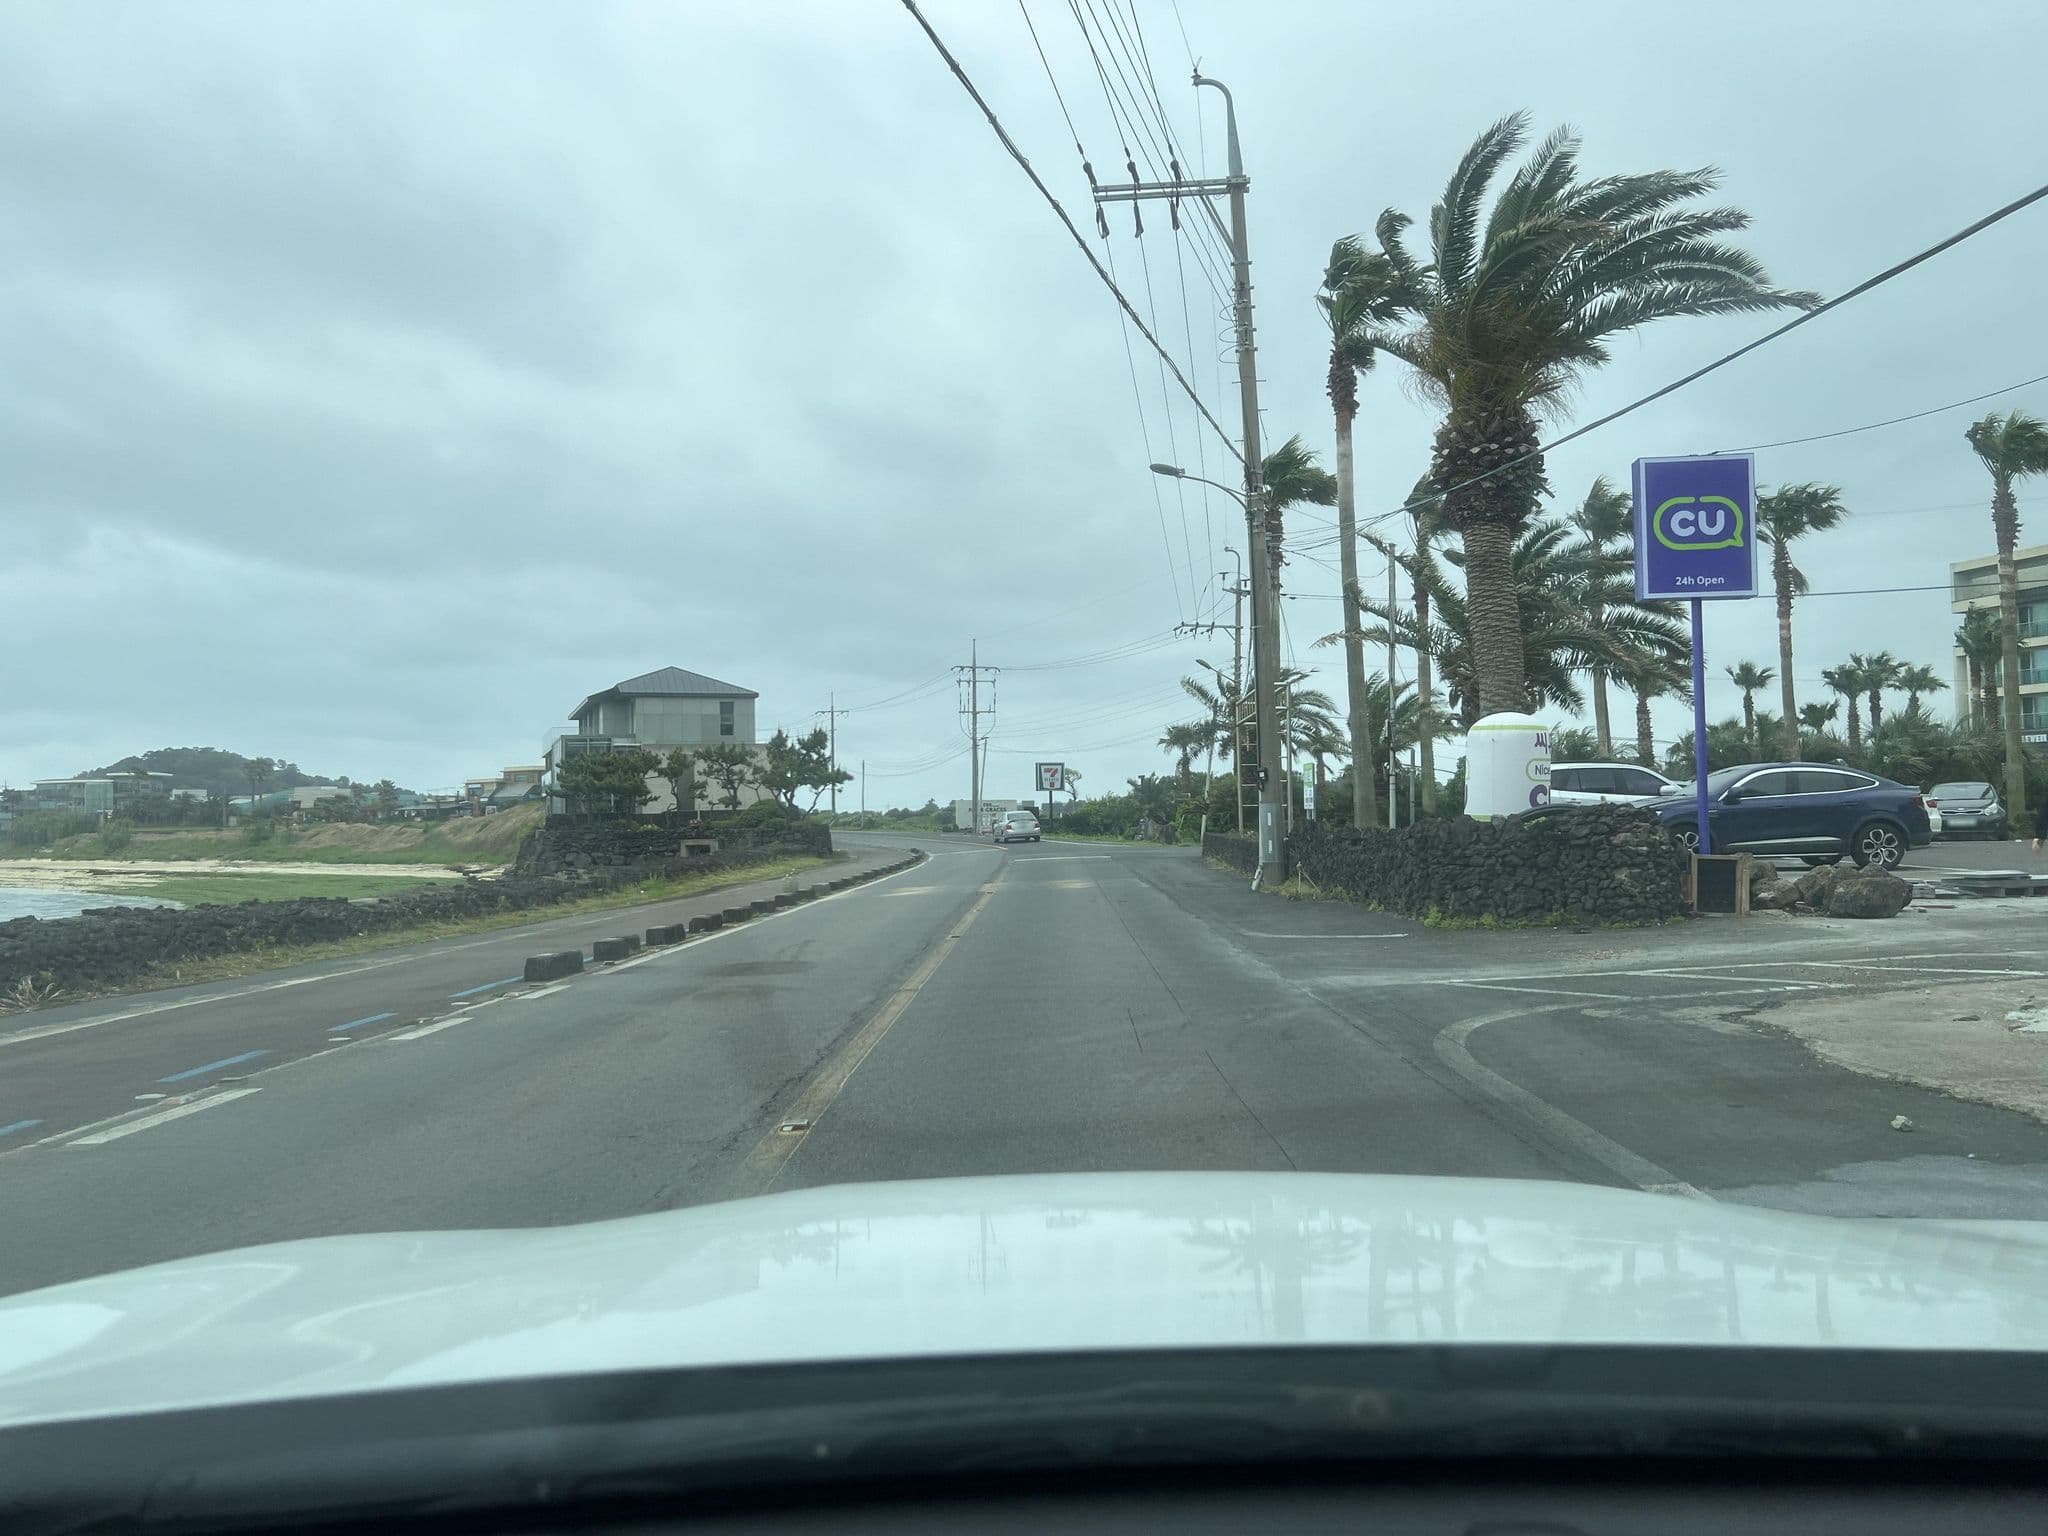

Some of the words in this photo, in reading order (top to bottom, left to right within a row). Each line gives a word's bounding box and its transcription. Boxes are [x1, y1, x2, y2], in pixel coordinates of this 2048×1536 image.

[1670, 509, 1725, 537] CU
[1675, 576, 1695, 586] 24h
[1696, 575, 1725, 587] Open
[1043, 767, 1058, 777] 7
[1529, 784, 1551, 808] C
